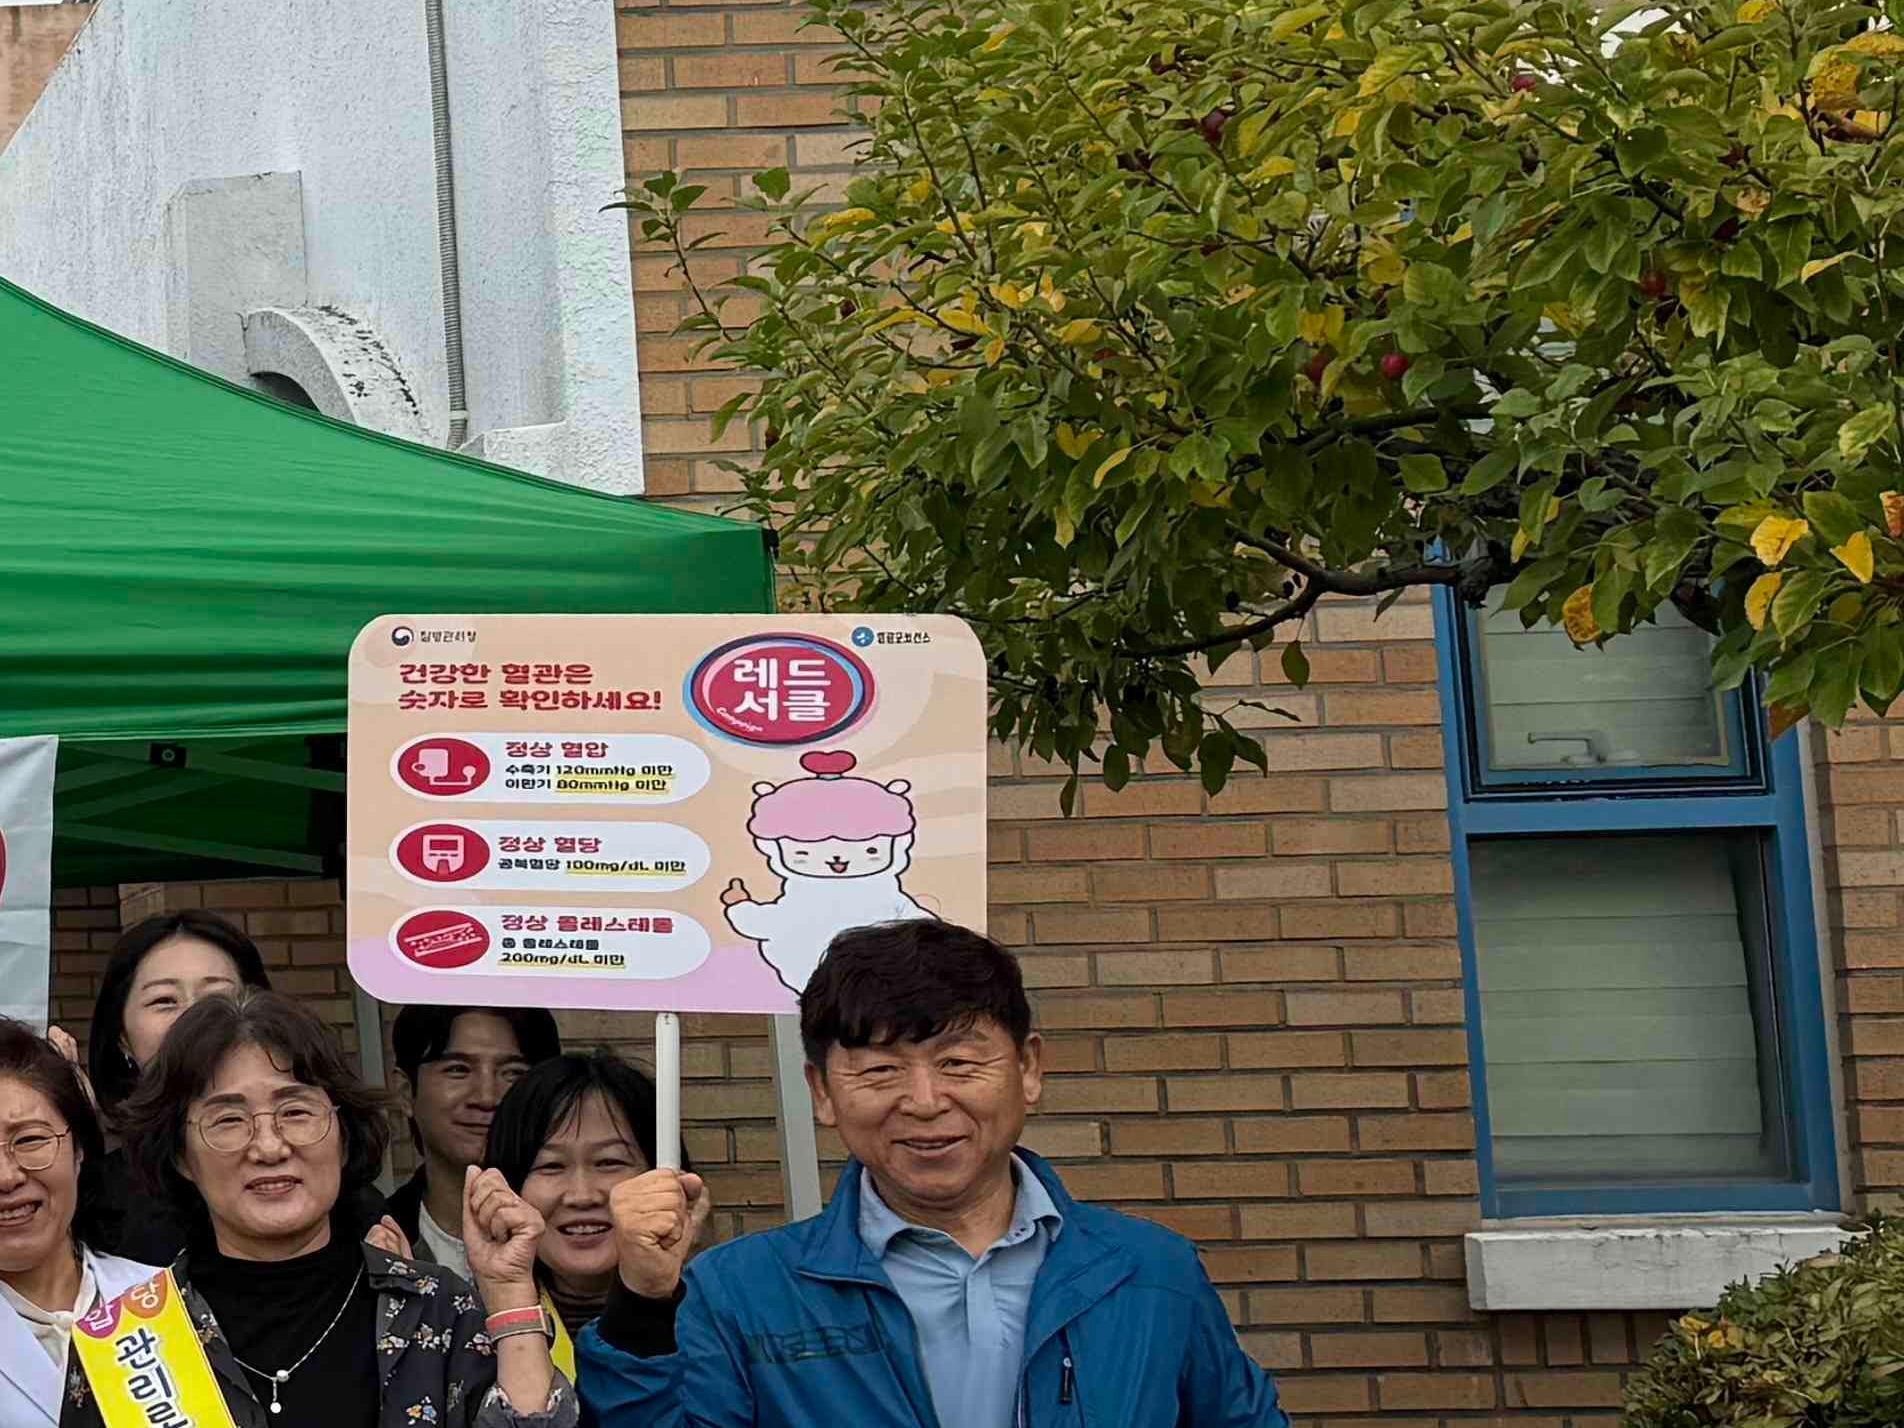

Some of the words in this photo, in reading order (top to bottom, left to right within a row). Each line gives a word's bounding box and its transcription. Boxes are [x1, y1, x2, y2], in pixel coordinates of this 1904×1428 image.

[399, 663, 491, 684] 건강한
[500, 663, 594, 684] 혈관은
[733, 658, 831, 688] 레드
[398, 689, 488, 710] 숫자로
[498, 689, 662, 710] 확인하세요!
[733, 689, 831, 721] 서클
[505, 741, 553, 758] 정상
[560, 741, 609, 758] 혈압
[556, 765, 636, 777] 120mmHg
[641, 765, 673, 776] 미만
[556, 779, 629, 791] 80mmHg
[635, 779, 666, 790] 미만
[498, 836, 546, 852] 정상
[554, 836, 602, 853] 혈당
[565, 859, 649, 872] 100mg/dL
[654, 860, 686, 872] 미만
[501, 914, 549, 932] 정상
[557, 916, 673, 933] 콜레스테롤
[500, 952, 590, 965] 200mg/dL
[594, 954, 625, 966] 미만
